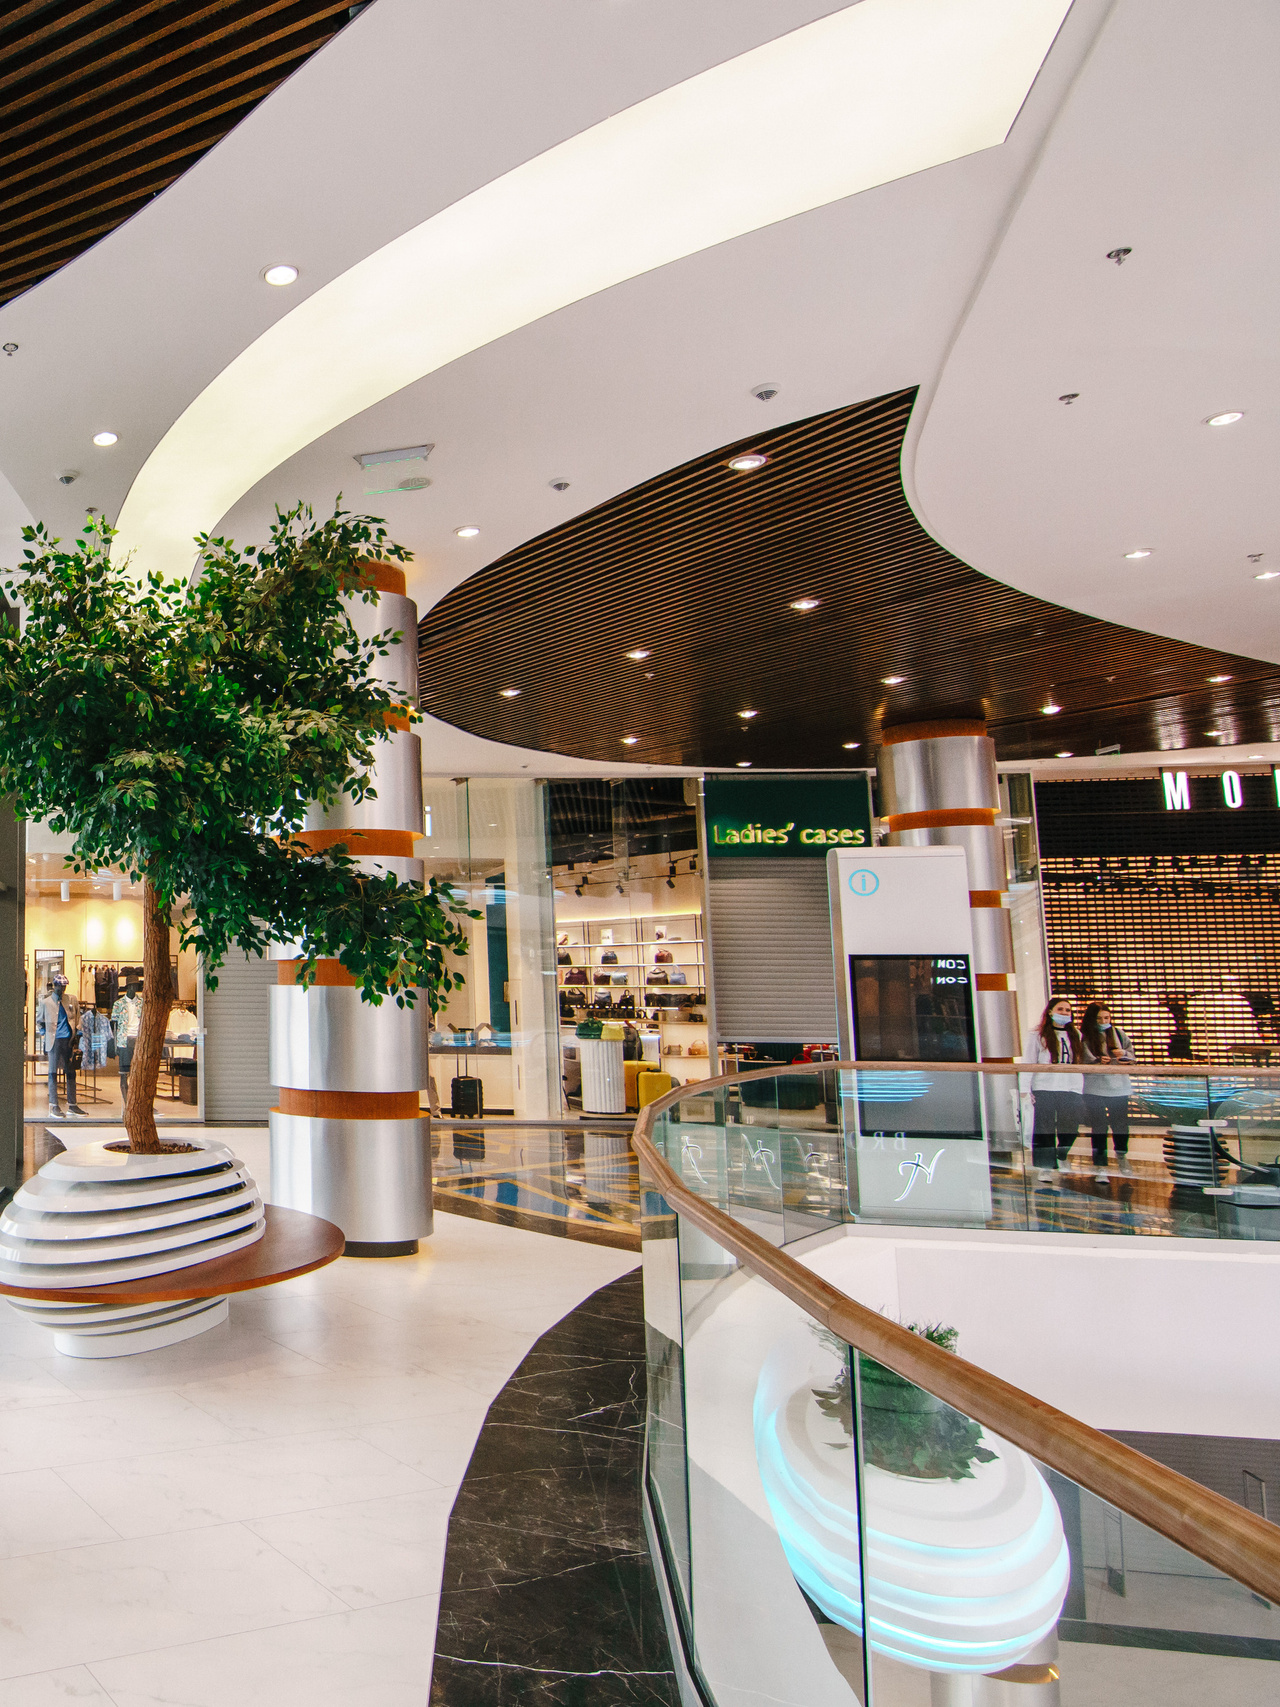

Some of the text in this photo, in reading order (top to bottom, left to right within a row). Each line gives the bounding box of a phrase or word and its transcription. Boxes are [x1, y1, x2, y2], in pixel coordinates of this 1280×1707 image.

[1162, 769, 1280, 811] MO
[714, 822, 865, 844] Ladies' cases
